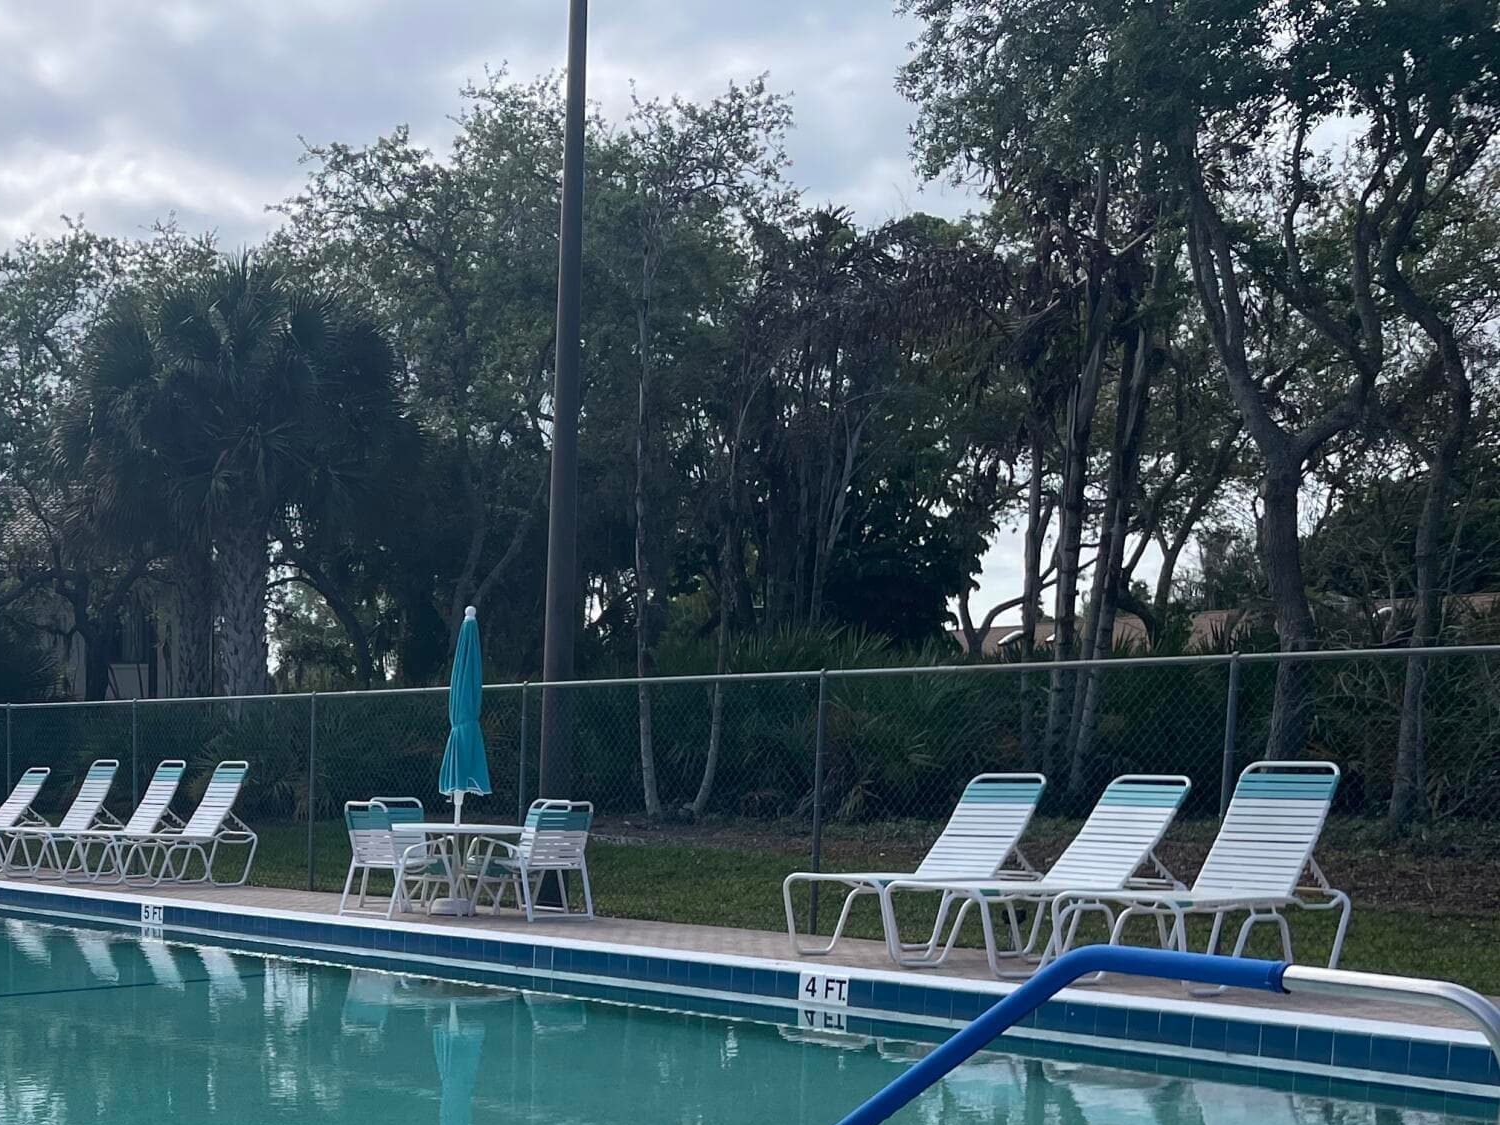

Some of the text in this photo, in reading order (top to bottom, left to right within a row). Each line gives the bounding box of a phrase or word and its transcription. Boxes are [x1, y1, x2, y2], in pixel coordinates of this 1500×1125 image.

[144, 905, 150, 919] 5
[805, 976, 847, 1001] 4 FT.
